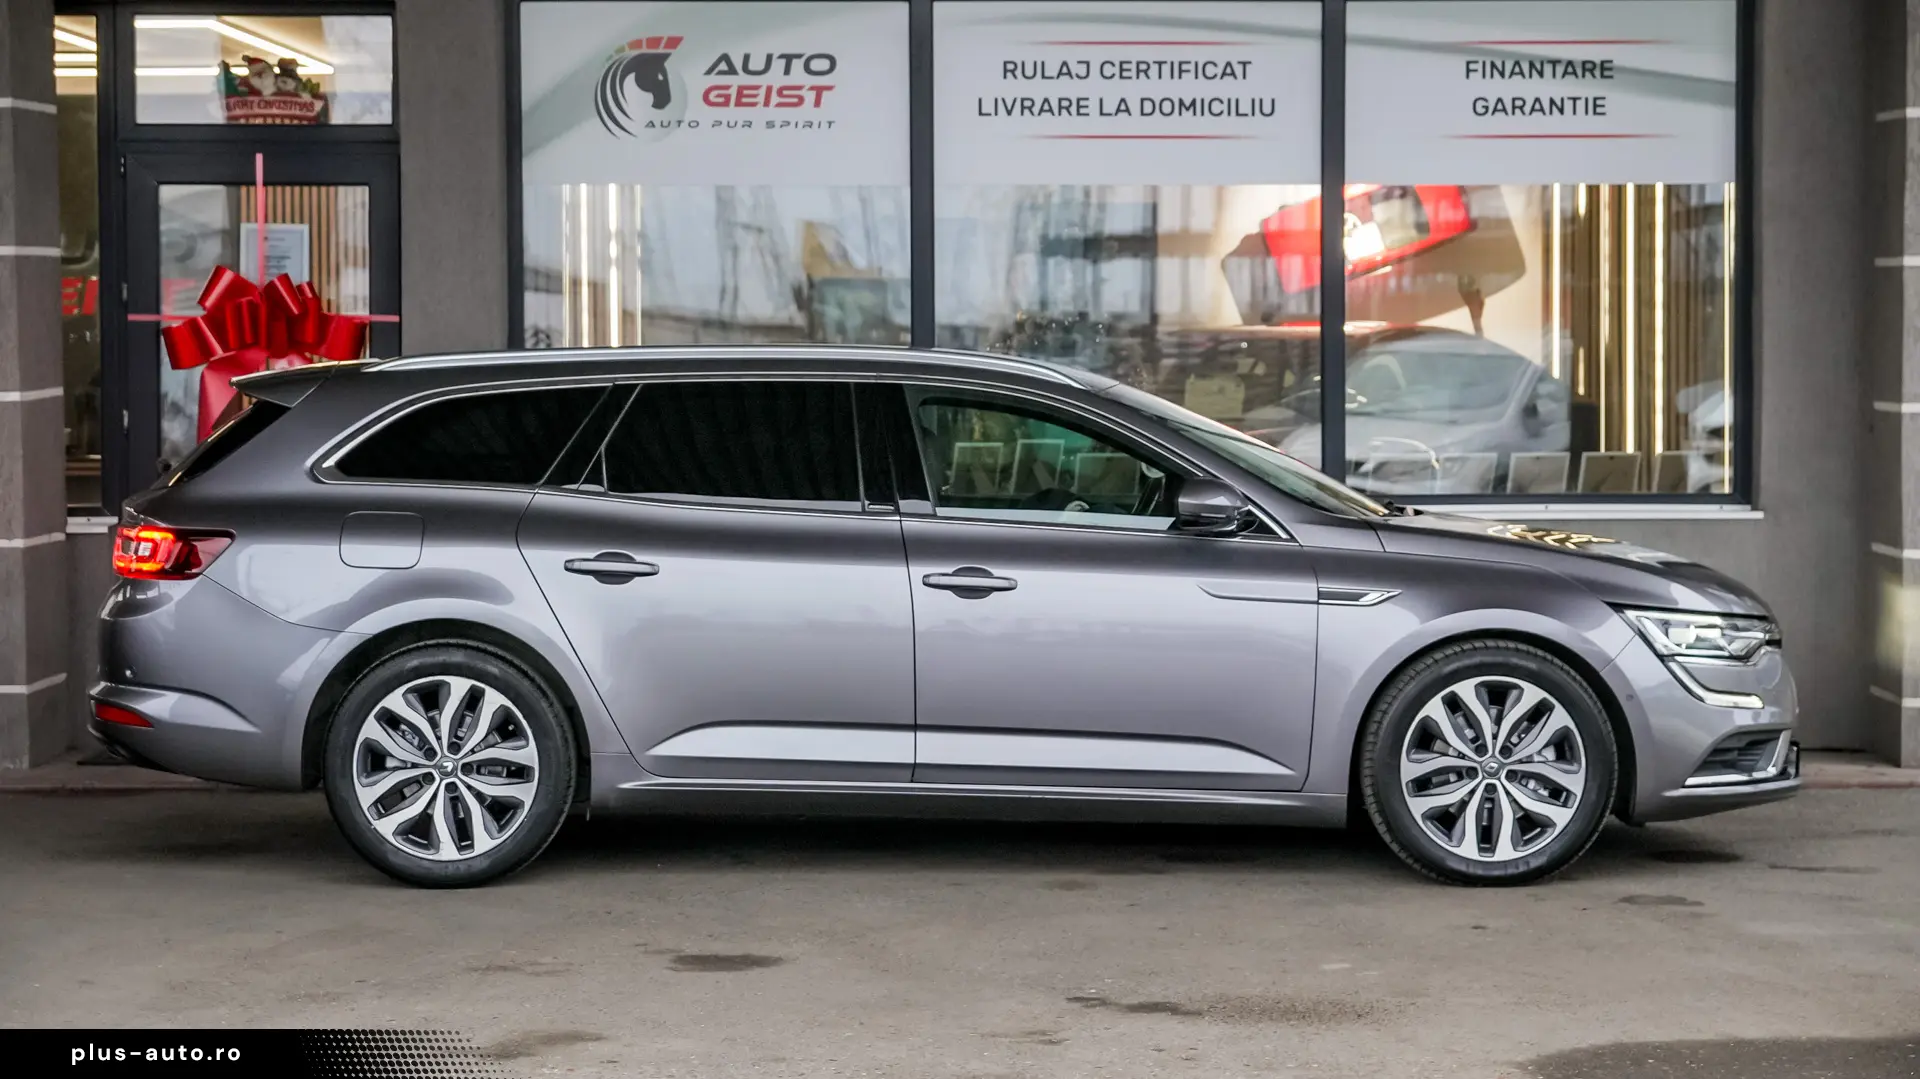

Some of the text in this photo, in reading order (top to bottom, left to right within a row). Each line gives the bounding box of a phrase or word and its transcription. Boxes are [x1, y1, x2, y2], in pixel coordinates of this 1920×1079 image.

[703, 52, 837, 77] AUTO
[1002, 60, 1253, 81] RULAJ CERTIFICAT
[1466, 59, 1614, 79] FINANTARE
[702, 84, 834, 108] GEIST
[1472, 96, 1607, 117] GARANTIE
[978, 97, 1276, 118] LIVRARE LA DOMICILIU
[644, 119, 836, 130] AUTO PUR SPIRIT
